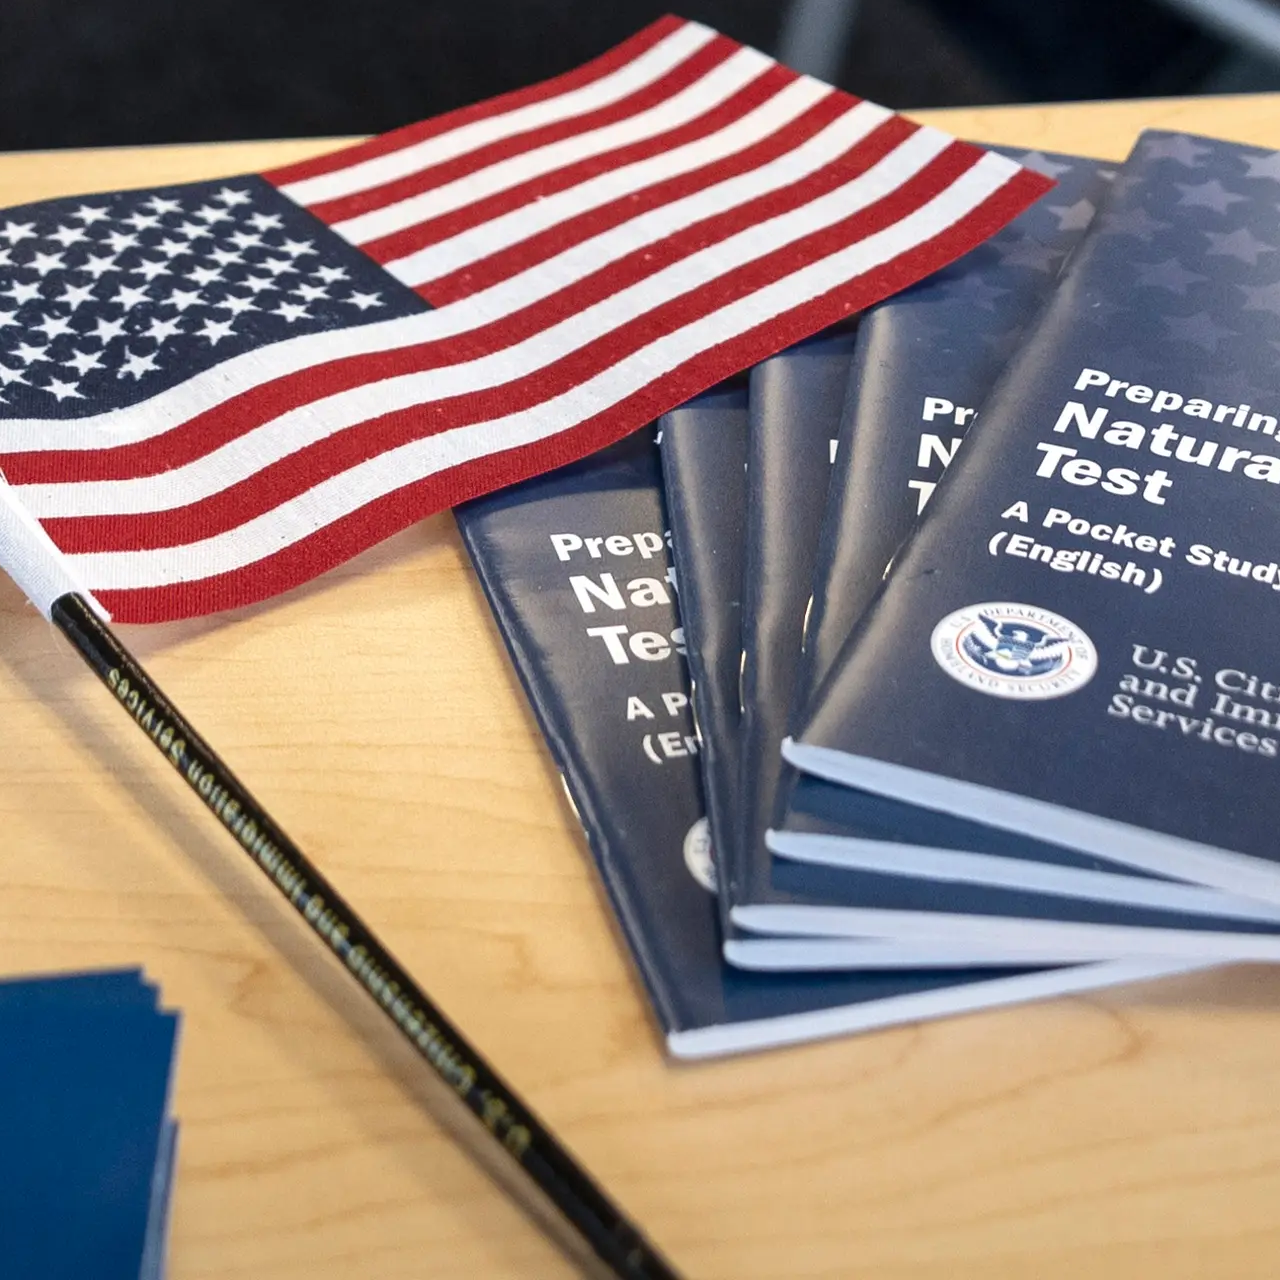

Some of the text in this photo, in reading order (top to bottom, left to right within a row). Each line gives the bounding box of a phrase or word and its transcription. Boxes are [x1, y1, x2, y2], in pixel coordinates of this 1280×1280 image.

[922, 396, 977, 426] Pr
[917, 433, 962, 468] N
[1034, 443, 1174, 506] Test
[907, 479, 937, 516] T
[549, 530, 672, 562] Prep
[1001, 500, 1029, 523] A
[1042, 507, 1177, 559] Pocket
[987, 530, 1164, 595] (English)
[1130, 643, 1203, 683] U.S.
[626, 691, 692, 721] A P
[1119, 673, 1199, 710] and
[108, 667, 187, 769] Services
[1106, 693, 1280, 758] Services
